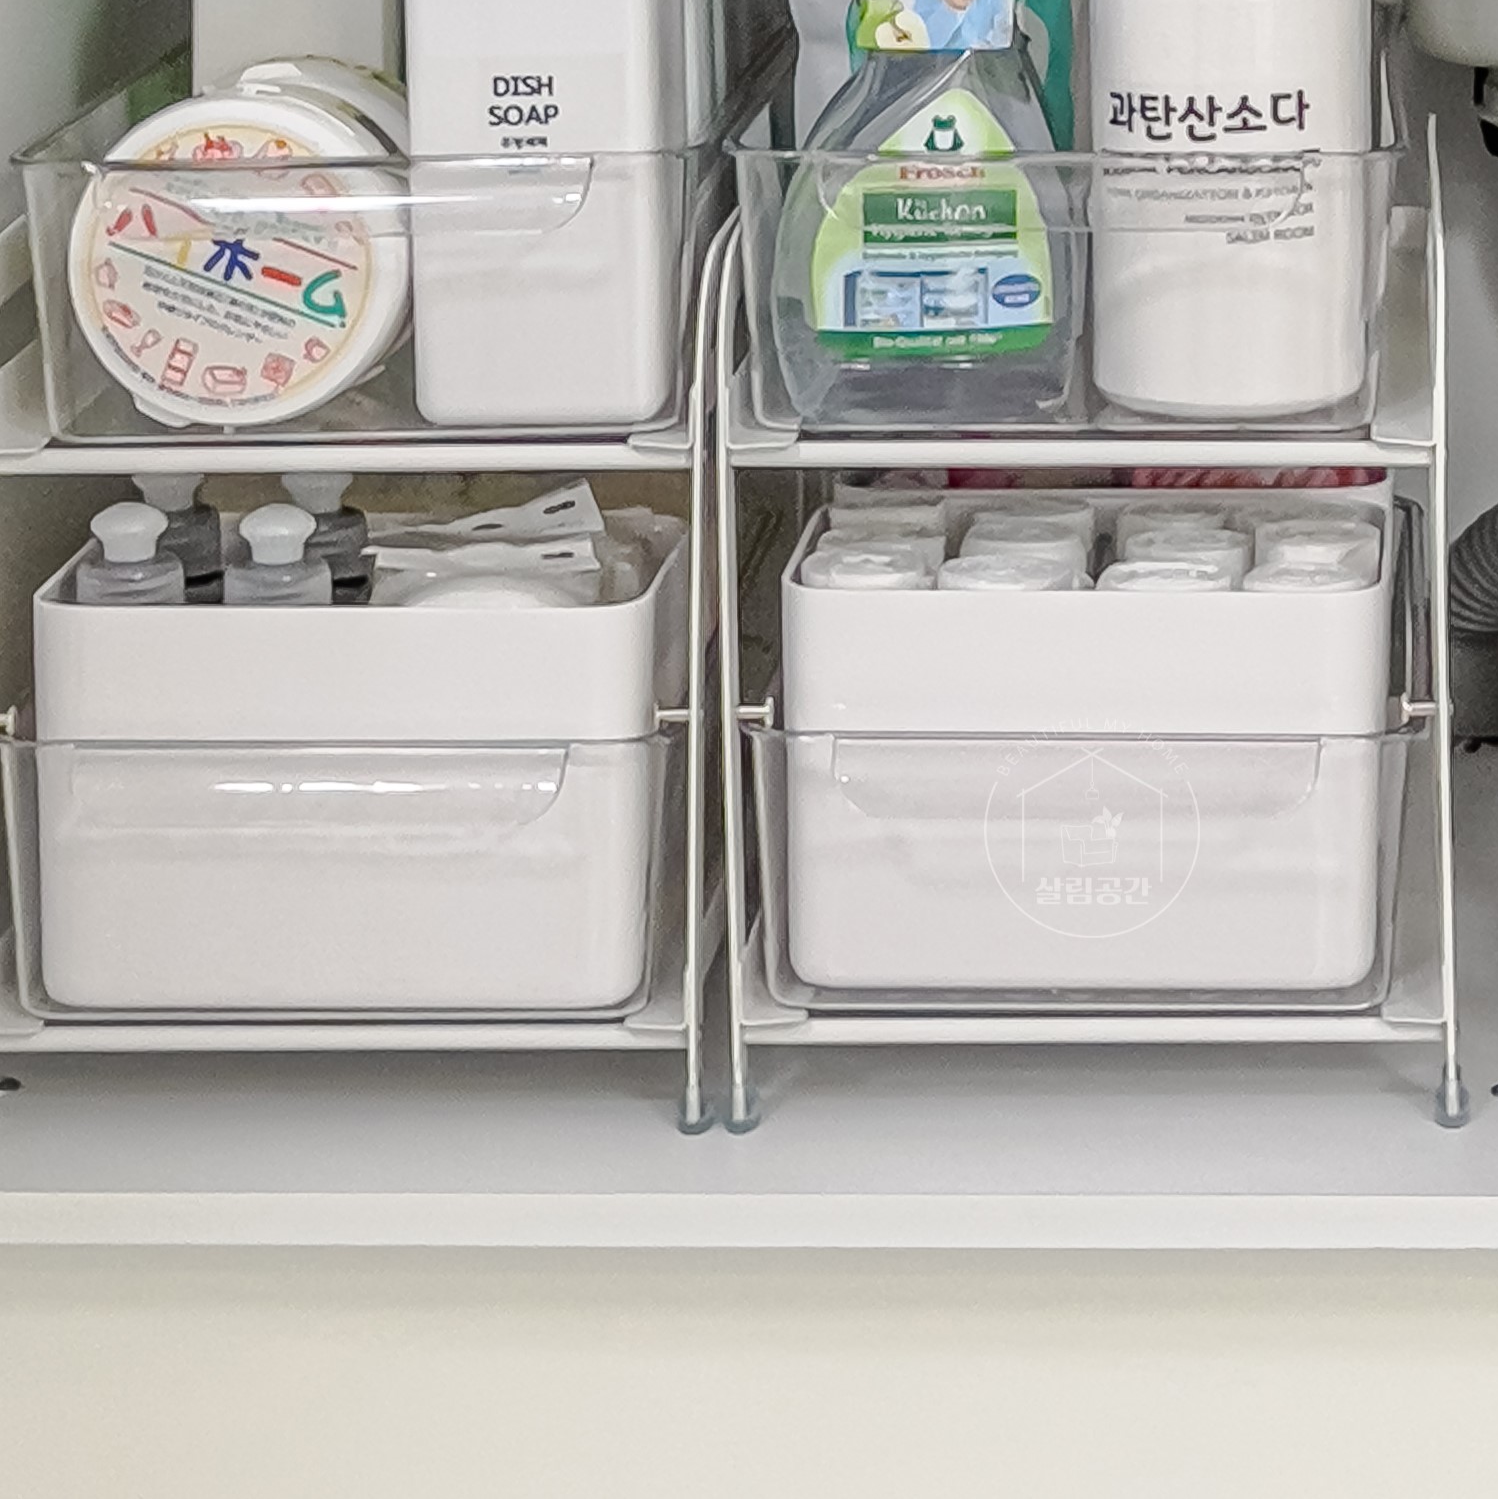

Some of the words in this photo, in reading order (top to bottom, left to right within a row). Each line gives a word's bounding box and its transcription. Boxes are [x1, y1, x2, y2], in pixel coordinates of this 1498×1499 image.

[493, 75, 553, 97] DISH
[488, 104, 559, 126] SOAP
[1109, 89, 1310, 141] 과탄산소다
[899, 166, 986, 180] Frosch
[897, 198, 987, 221] Küchen
